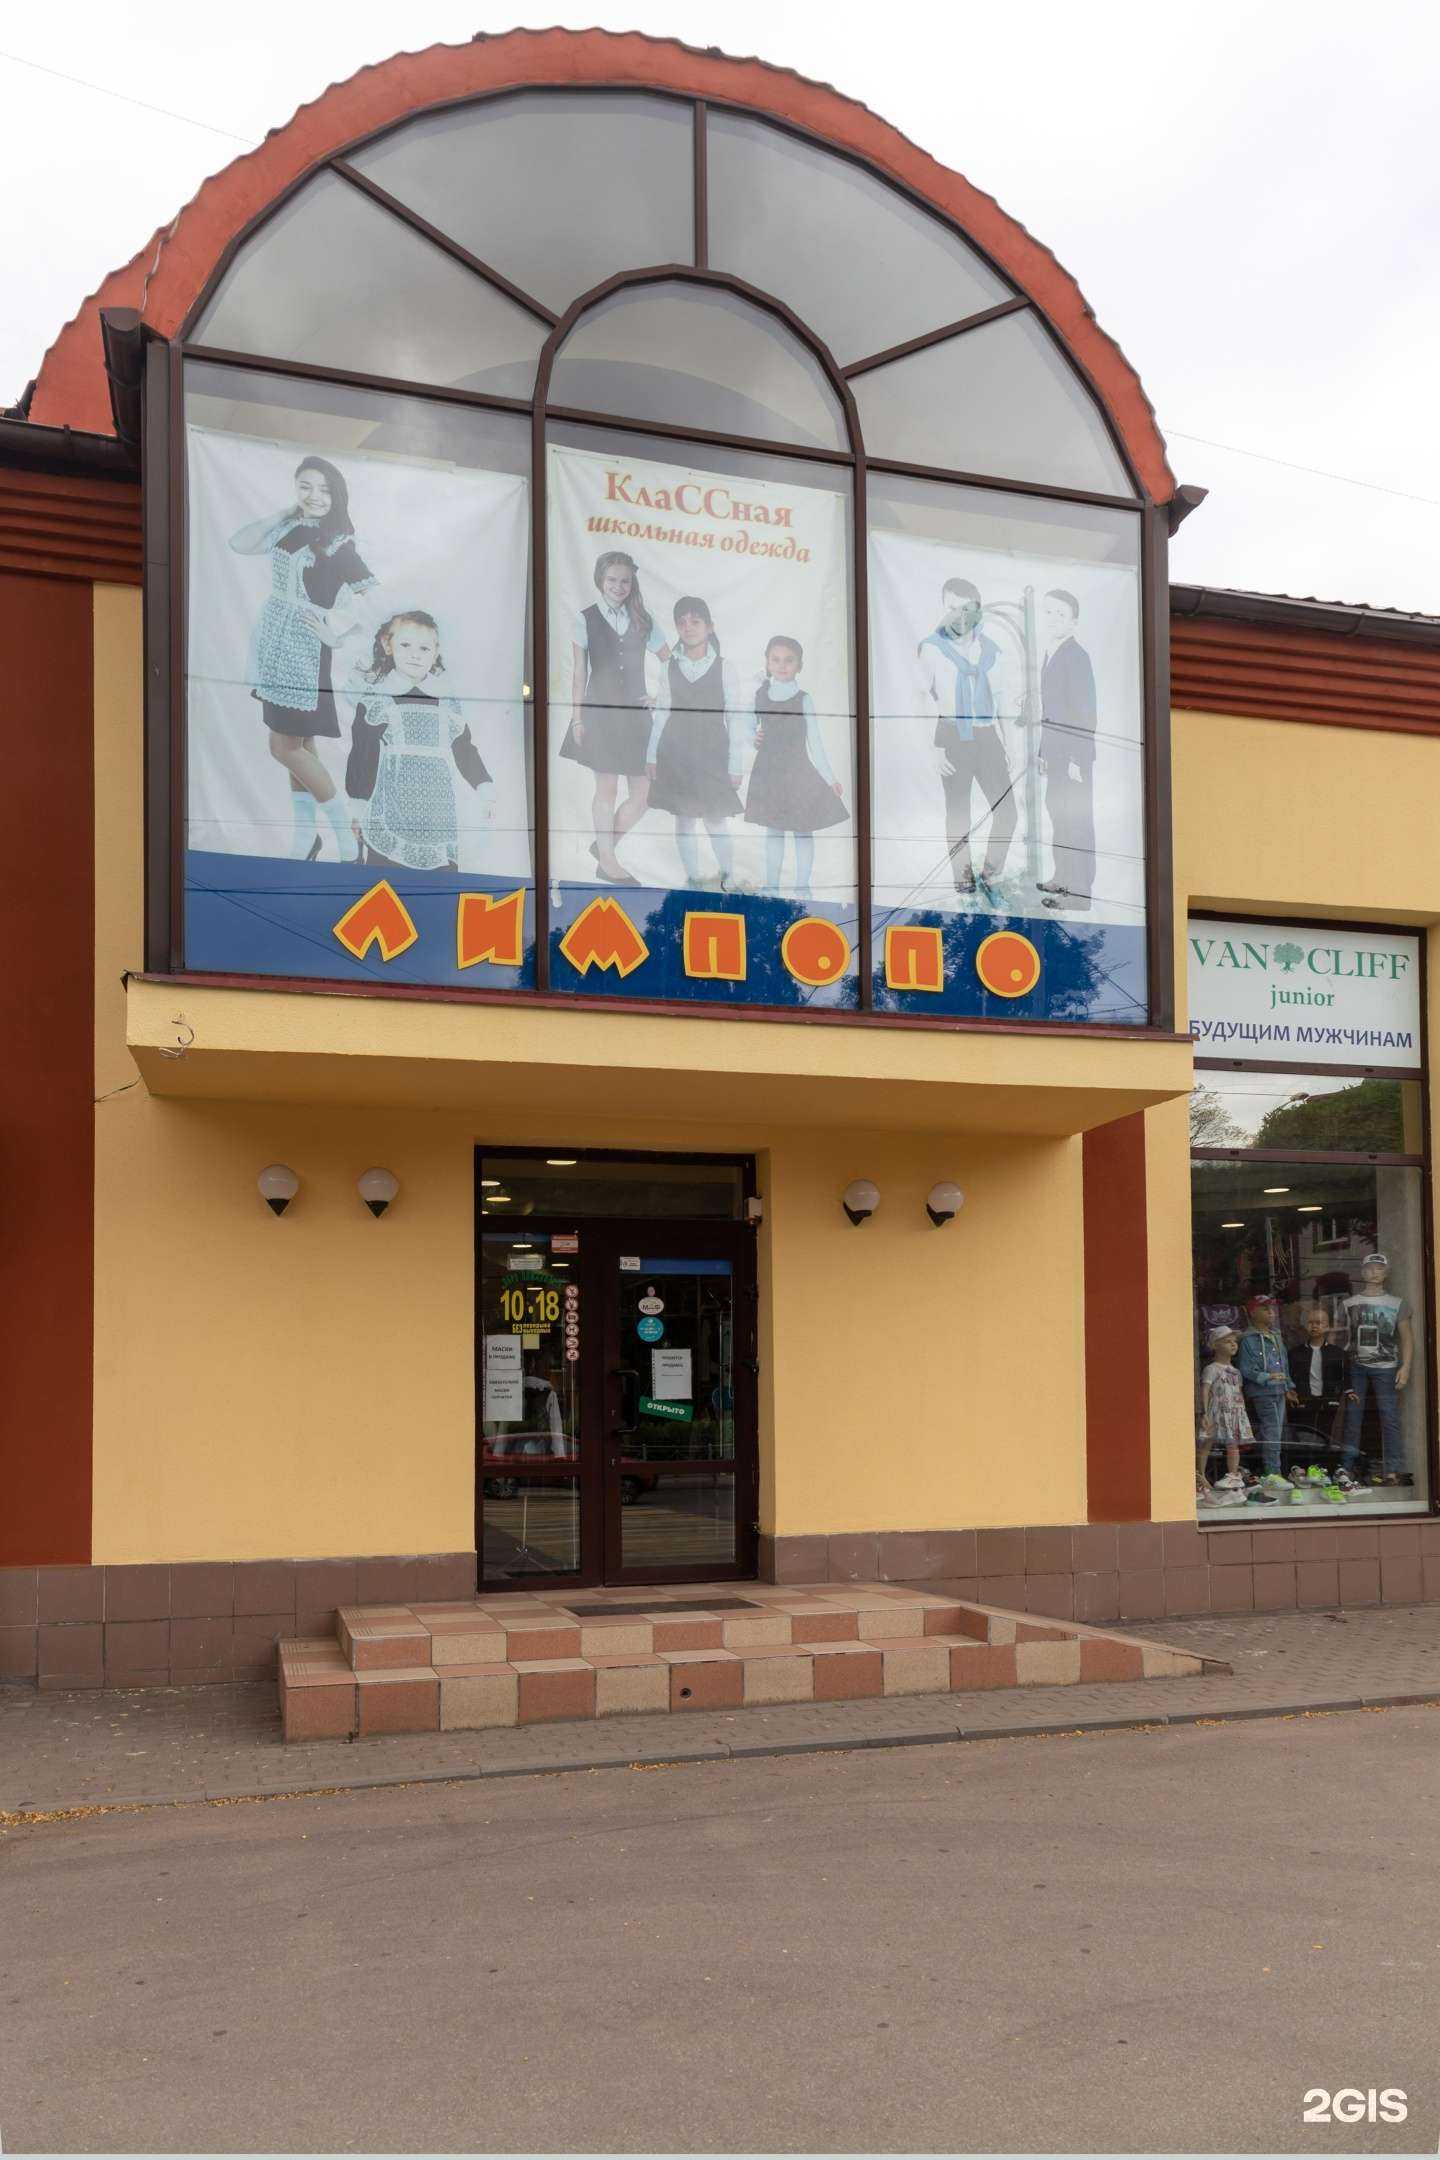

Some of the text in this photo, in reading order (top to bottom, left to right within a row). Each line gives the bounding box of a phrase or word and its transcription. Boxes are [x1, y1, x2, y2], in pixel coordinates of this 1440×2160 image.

[604, 471, 793, 528] КлаССная
[586, 515, 811, 563] школьная одежда
[332, 878, 1042, 999] ЛИМПОПО
[1190, 938, 1410, 980] VAN CLIFF
[1270, 984, 1335, 1009] junior
[1189, 1019, 1413, 1049] БУДУЩИМ МУЖЧИНАМ
[646, 1402, 686, 1416] ОТКРЫТО
